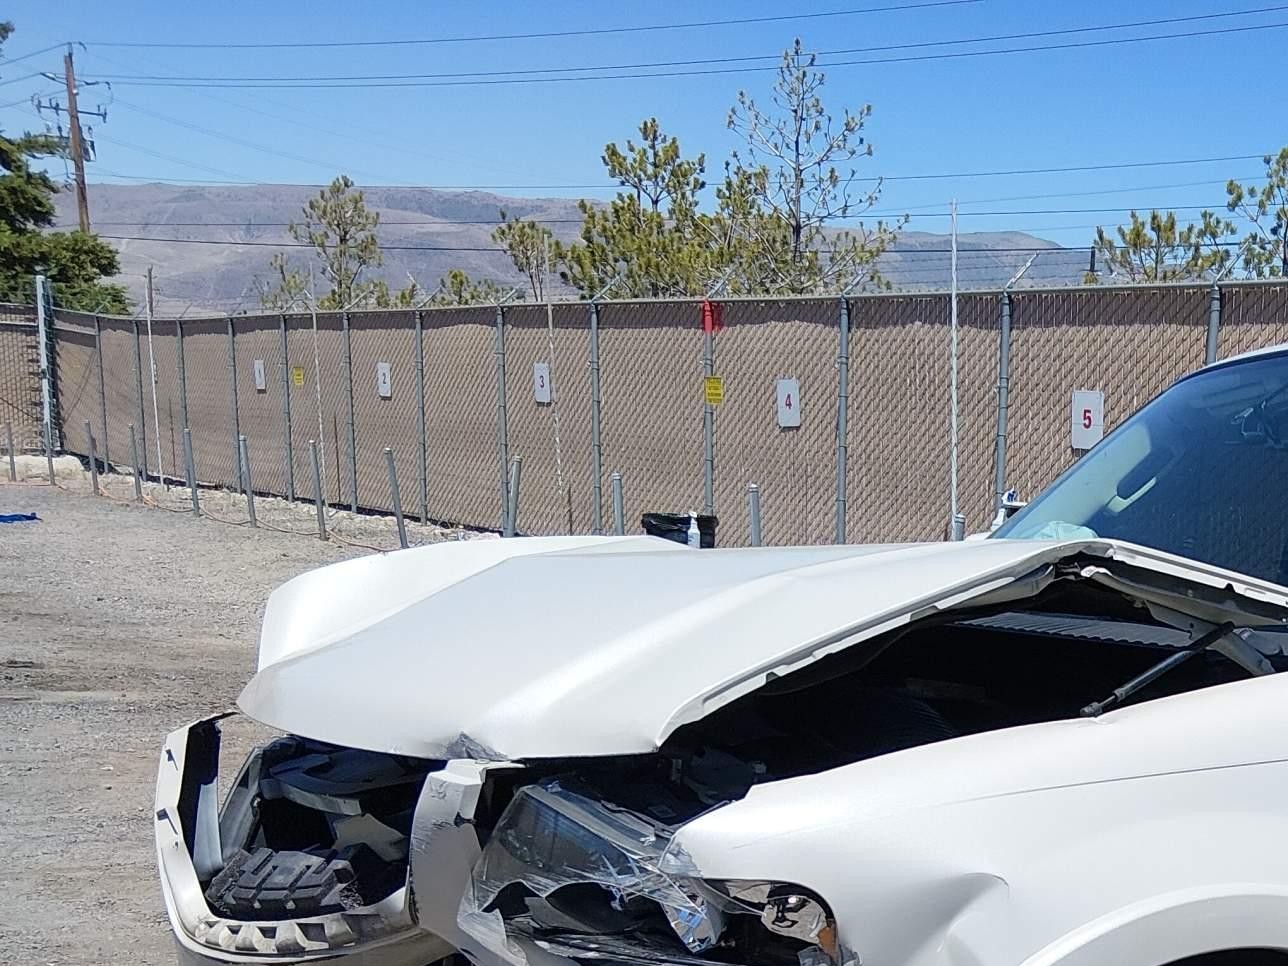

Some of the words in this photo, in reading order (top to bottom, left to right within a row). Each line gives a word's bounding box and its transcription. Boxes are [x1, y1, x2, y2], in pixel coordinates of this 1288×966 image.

[382, 372, 387, 385] 2
[540, 375, 545, 389] 3
[785, 393, 792, 410] 4
[1083, 409, 1092, 429] 5
